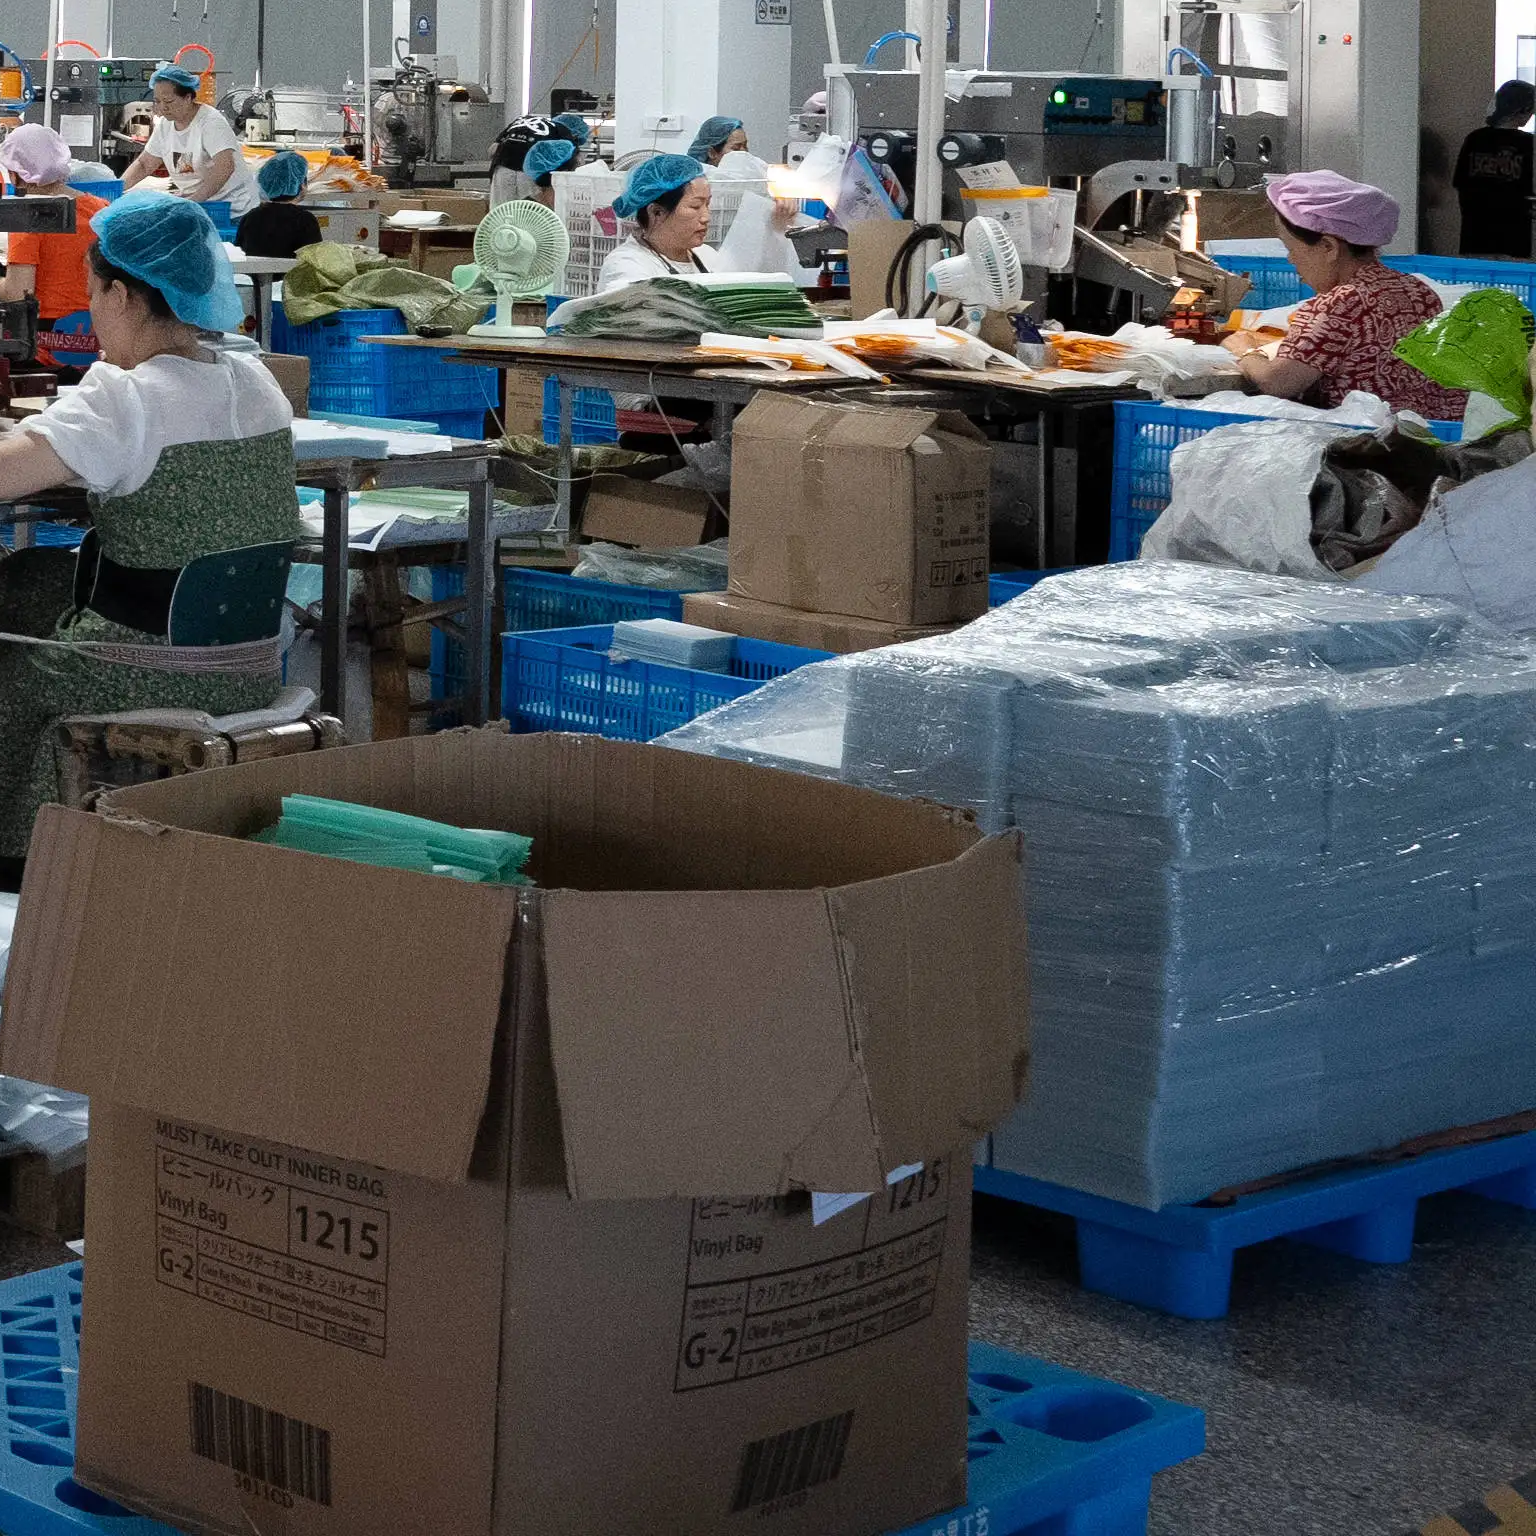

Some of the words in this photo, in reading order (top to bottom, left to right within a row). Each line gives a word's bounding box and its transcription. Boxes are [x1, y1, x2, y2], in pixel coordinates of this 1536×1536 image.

[156, 1118, 198, 1145] MUST
[202, 1133, 244, 1161] TAKE
[247, 1147, 284, 1168] OUT
[288, 1158, 342, 1187] INNER
[345, 1172, 390, 1199] BAG.
[161, 1153, 277, 1204] ビニールバッグ
[158, 1186, 195, 1218] Vinyl
[197, 1202, 228, 1231] Bag
[889, 1159, 942, 1213] 1215
[295, 1205, 379, 1261] 1215
[693, 1235, 732, 1260] Vinyl
[735, 1233, 764, 1254] Bag
[159, 1247, 194, 1281] G-2
[685, 1327, 737, 1369] G-2
